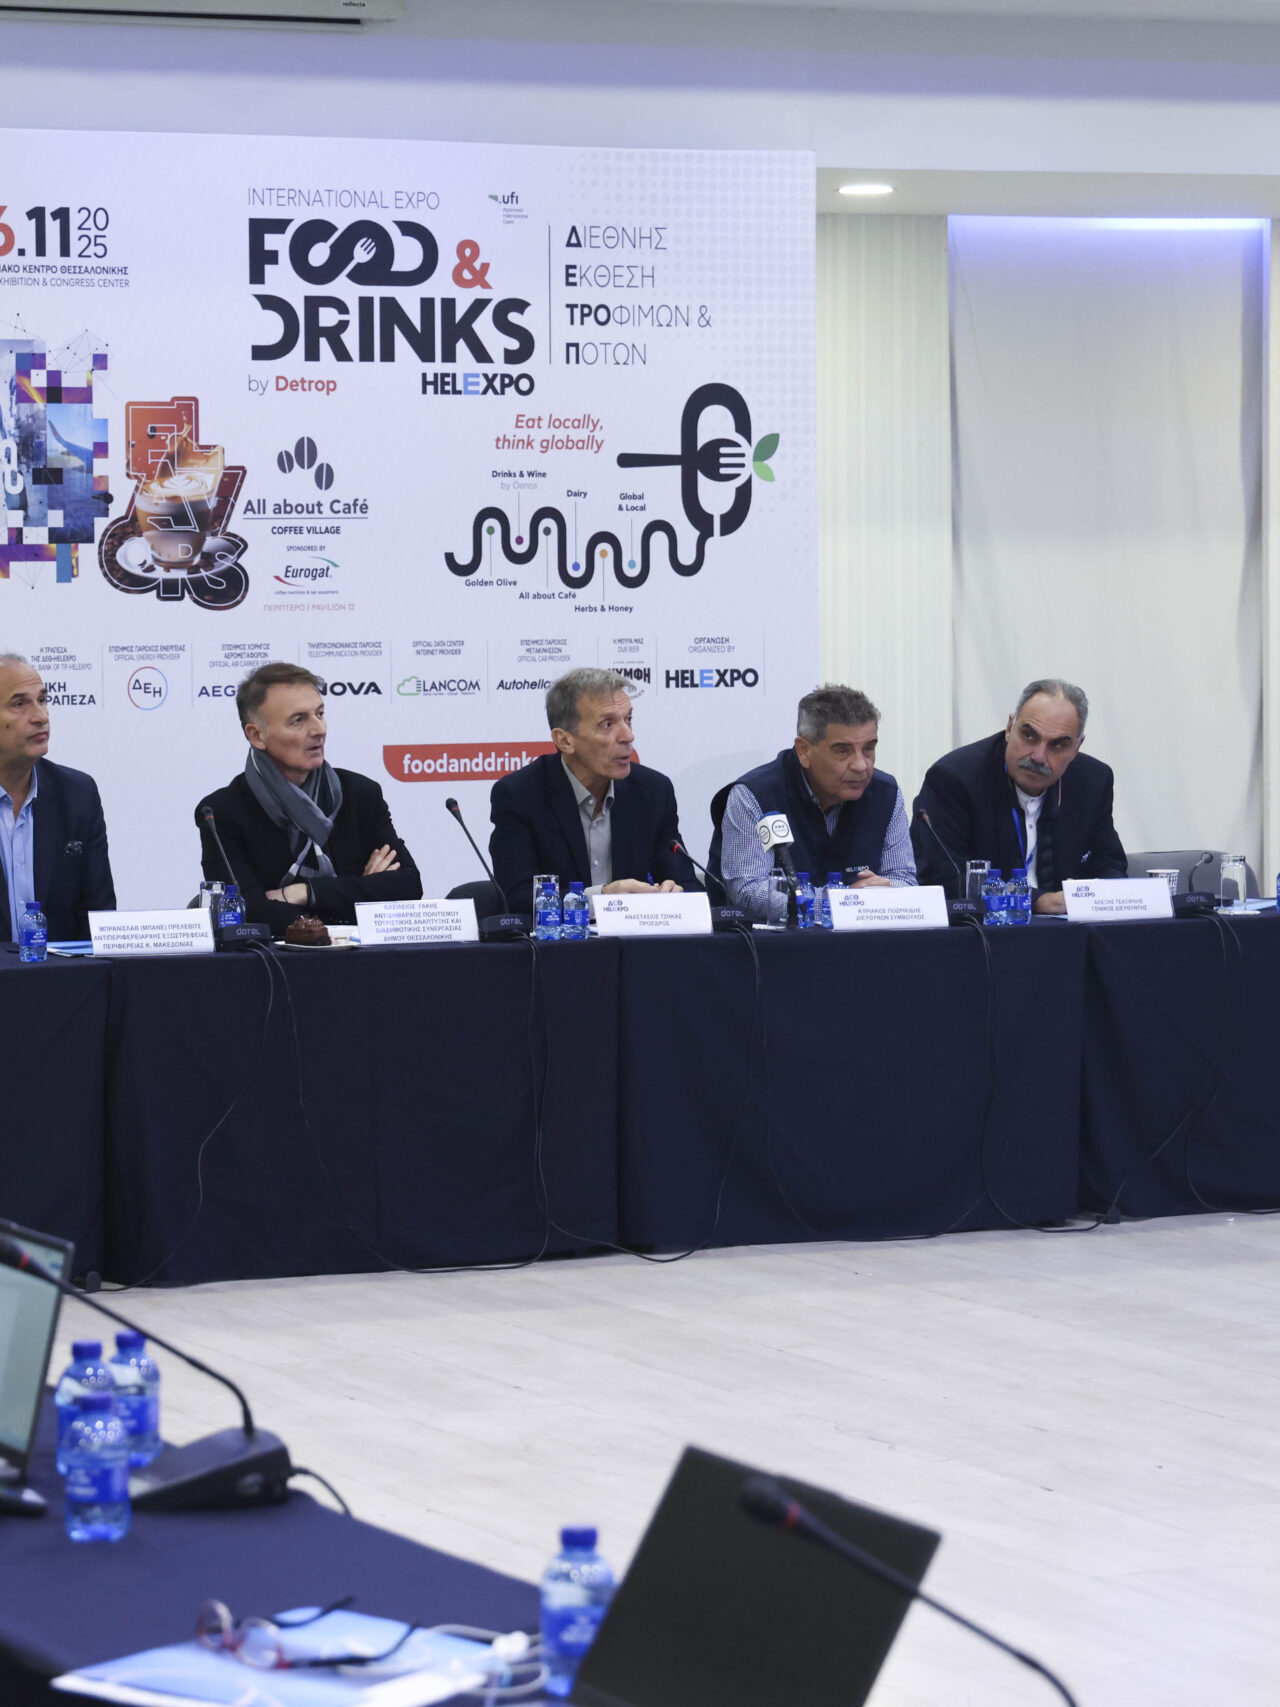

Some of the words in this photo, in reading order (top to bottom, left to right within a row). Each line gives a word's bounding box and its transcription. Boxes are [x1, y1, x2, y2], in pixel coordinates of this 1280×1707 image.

[248, 188, 389, 209] INTERNATIONAL
[394, 191, 440, 210] EXPO
[502, 192, 519, 204] ufi
[565, 225, 667, 250] ΔΙΕΘΝΗΣ
[248, 218, 439, 287] FOOD
[452, 239, 493, 289] &
[23, 264, 58, 274] ΚΕΝΤΡΟ
[60, 265, 129, 275] ΘΕΣΣΑΛΟΝΙΚΗΣ
[565, 264, 655, 288] ΕΚΘΕΣΗ
[42, 277, 48, 287] &
[49, 278, 95, 287] CONGRESS
[97, 278, 130, 288] CENTER
[565, 304, 689, 327] ΤΡΟΦΙΜΩΝ
[697, 305, 712, 328] &
[251, 294, 535, 365] DRINKS
[565, 342, 647, 365] ΠΟΤΩΝ
[248, 374, 269, 396] by
[275, 375, 337, 396] Detrop
[421, 372, 535, 396] HELEXPO
[515, 414, 543, 429] Eat
[548, 413, 604, 433] locally,
[495, 434, 535, 450] think
[539, 434, 605, 454] globally
[491, 470, 517, 478] Drinks
[518, 470, 525, 478] &
[527, 470, 547, 478] Wine
[566, 490, 587, 499] Dairy
[619, 492, 644, 501] Global
[243, 499, 266, 515] All
[272, 499, 324, 515] about
[329, 498, 369, 514] Café
[271, 526, 304, 535] COFFEE
[306, 526, 341, 534] VILLAGE
[284, 565, 330, 580] Eurogat
[557, 591, 577, 599] Café
[600, 605, 605, 613] &
[608, 605, 634, 614] Honey
[423, 679, 480, 692] LANCOM
[497, 679, 551, 690] Autohella
[665, 668, 759, 688] HELEXPO
